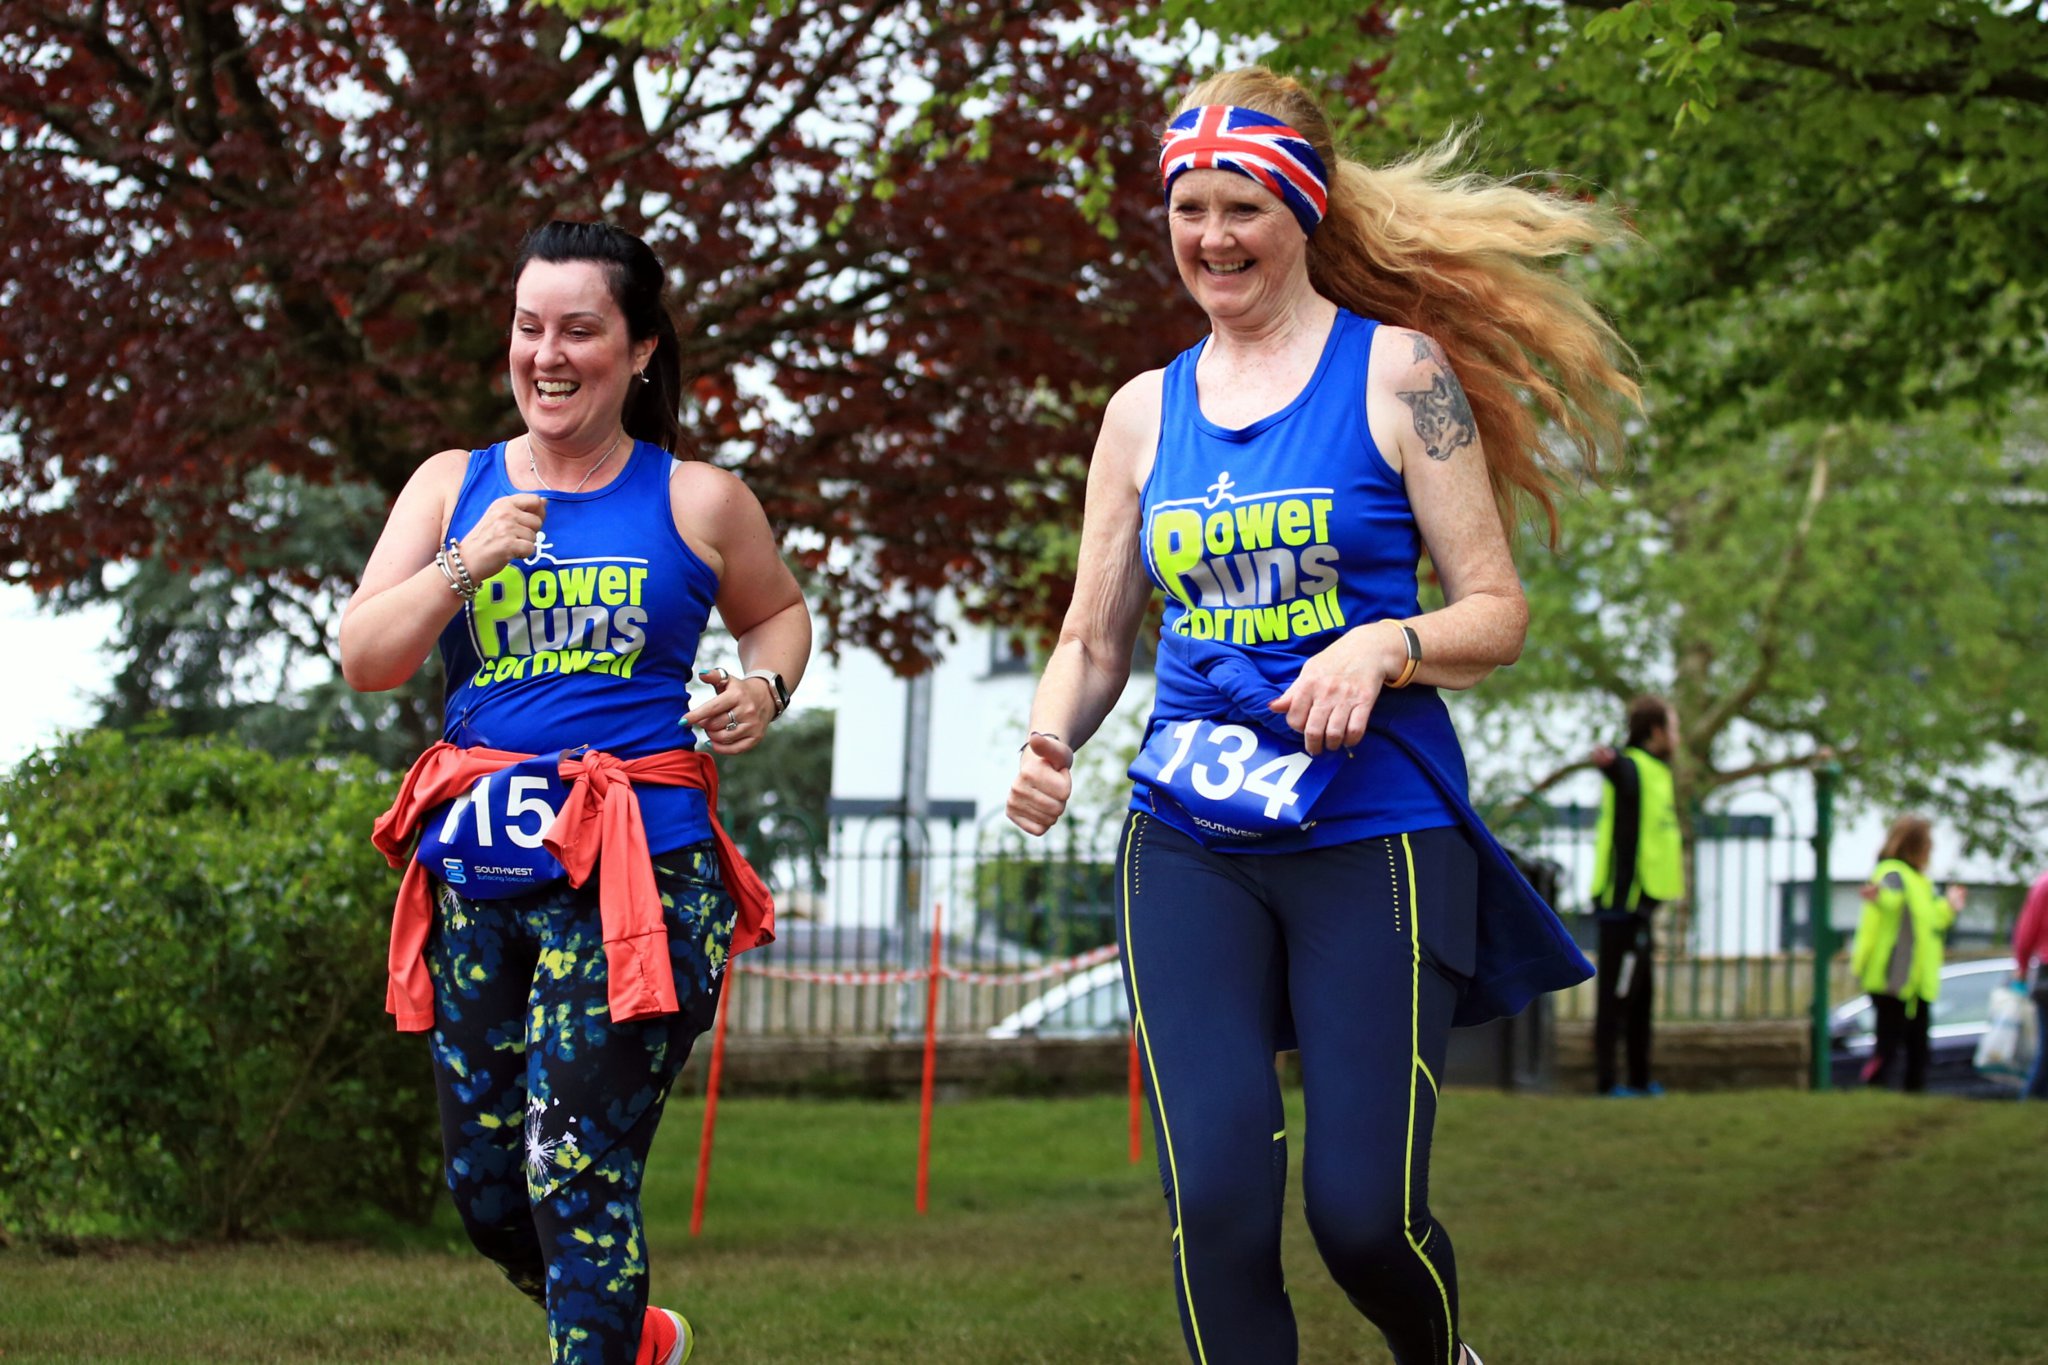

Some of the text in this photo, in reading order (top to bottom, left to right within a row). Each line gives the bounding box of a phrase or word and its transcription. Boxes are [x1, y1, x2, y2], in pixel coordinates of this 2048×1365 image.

[1153, 498, 1333, 610] Power
[474, 563, 648, 657] Power
[1156, 719, 1313, 820] 134
[473, 865, 533, 876] SOUTHWEST
[1192, 816, 1263, 838] SOUTHWEST
